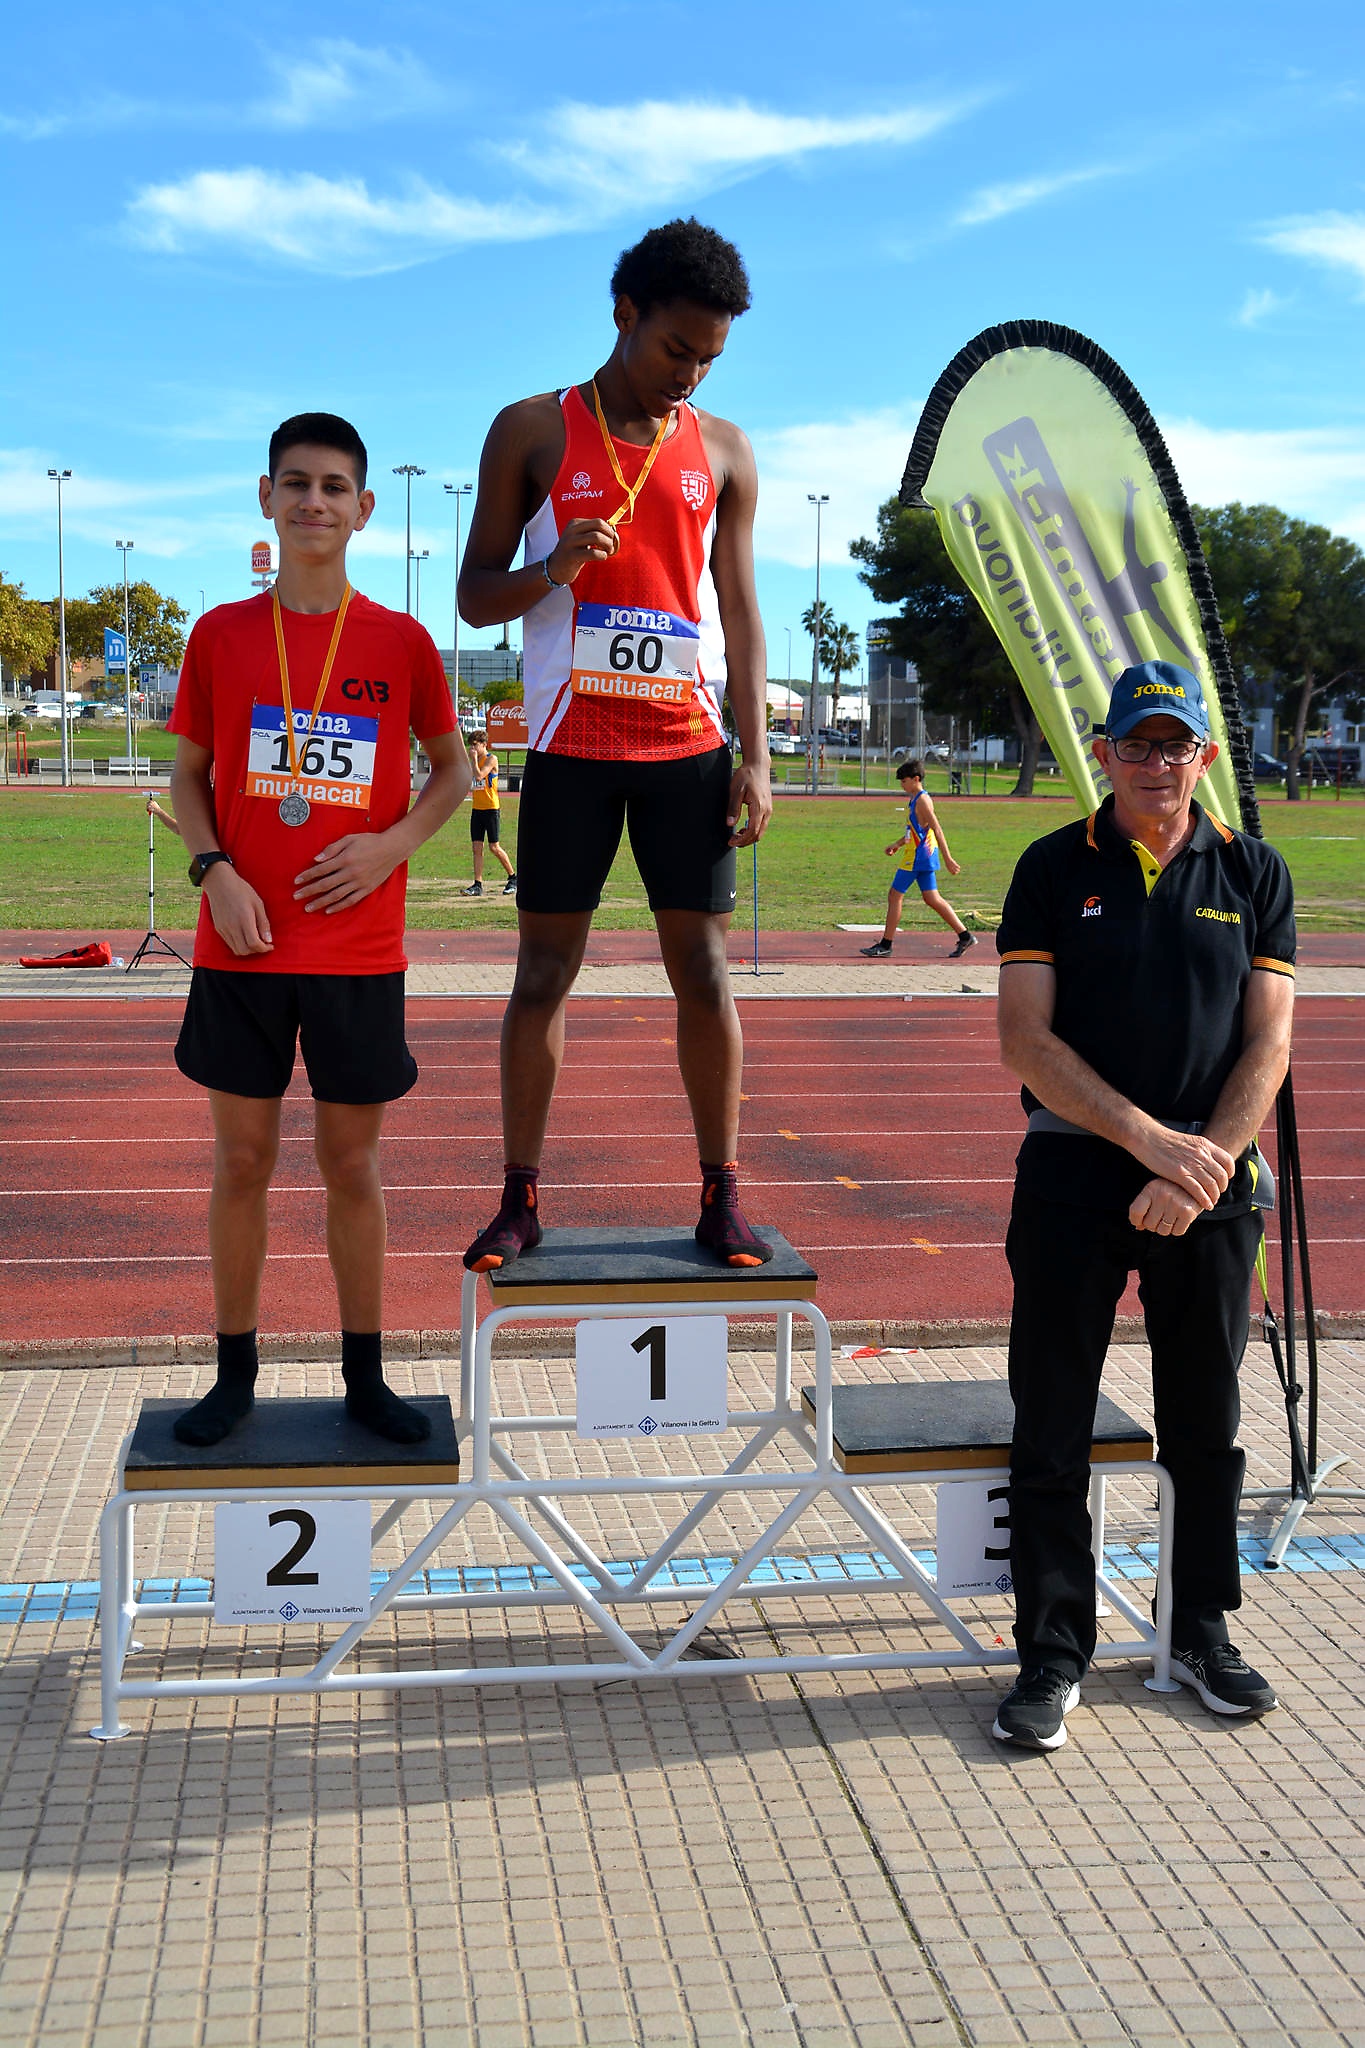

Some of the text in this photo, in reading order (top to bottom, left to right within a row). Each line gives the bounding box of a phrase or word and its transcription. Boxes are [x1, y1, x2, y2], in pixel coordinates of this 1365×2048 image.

[252, 558, 271, 567] KING
[609, 632, 663, 674] 60
[579, 676, 683, 700] mutuacat
[271, 734, 353, 779] 165
[254, 777, 362, 805] mutuacat
[1195, 907, 1241, 925] CATALUNYA
[630, 1325, 666, 1400] 1
[660, 1421, 688, 1429] Vilanova
[984, 1486, 1012, 1560] 3
[266, 1508, 319, 1586] 2
[302, 1606, 331, 1615] Vilanova
